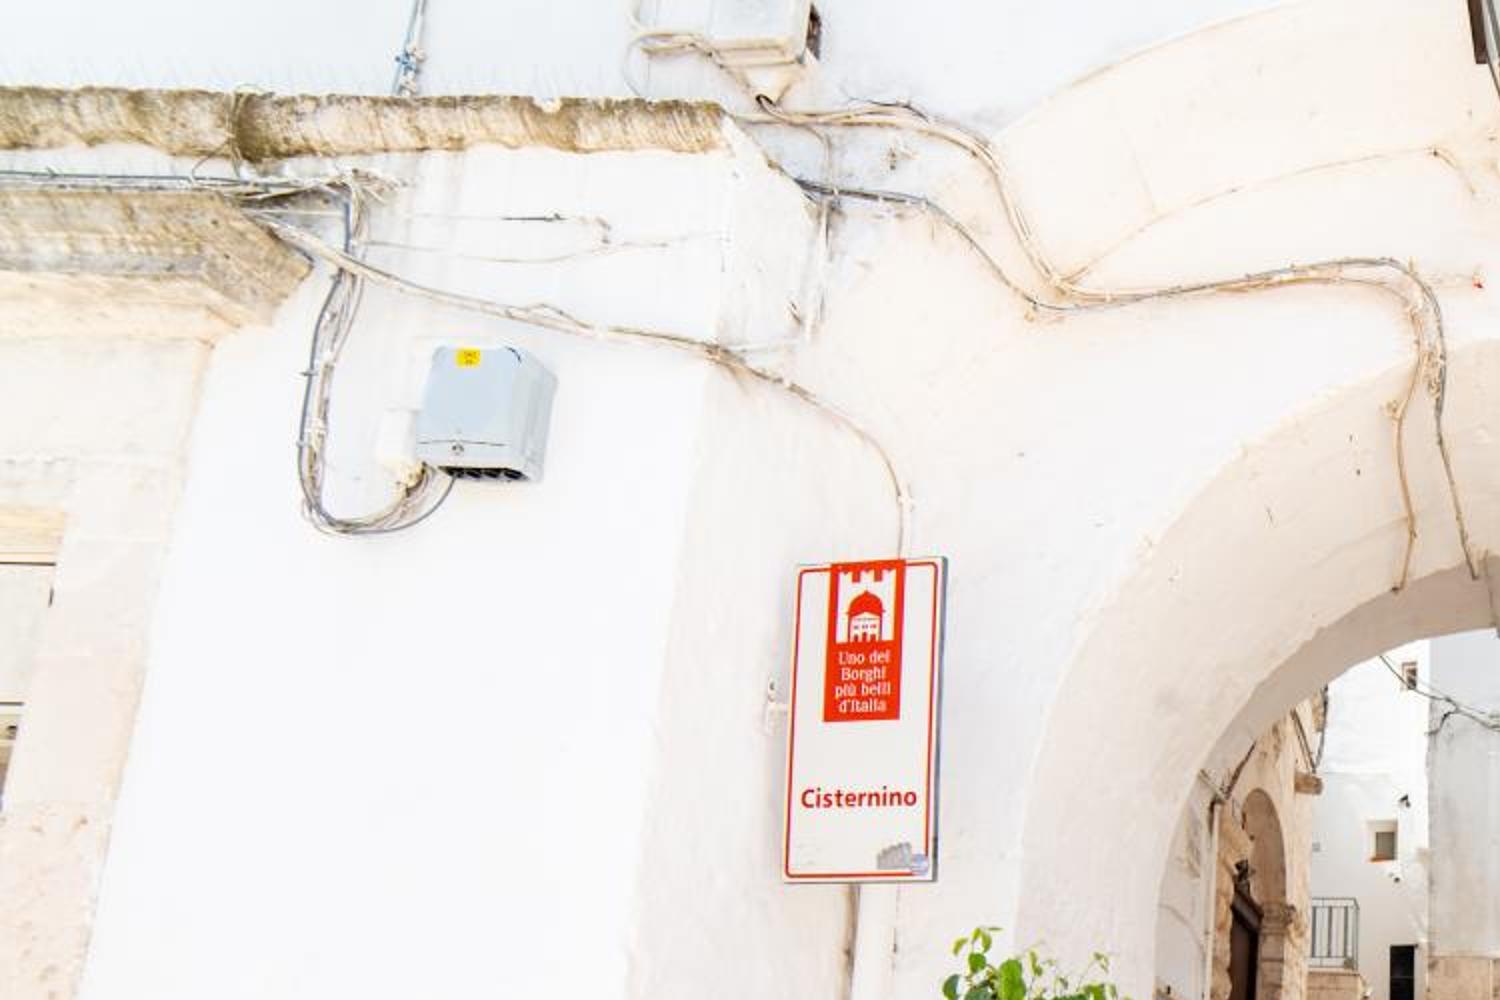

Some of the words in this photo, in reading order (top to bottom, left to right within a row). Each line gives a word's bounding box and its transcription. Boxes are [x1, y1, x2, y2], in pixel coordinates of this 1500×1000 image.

[838, 651, 865, 665] Uno
[869, 649, 891, 664] dei
[841, 666, 887, 683] Borghi
[835, 682, 857, 700] più
[861, 681, 891, 697] belli
[839, 698, 887, 714] d'Italia
[801, 785, 917, 809] Cisternino
